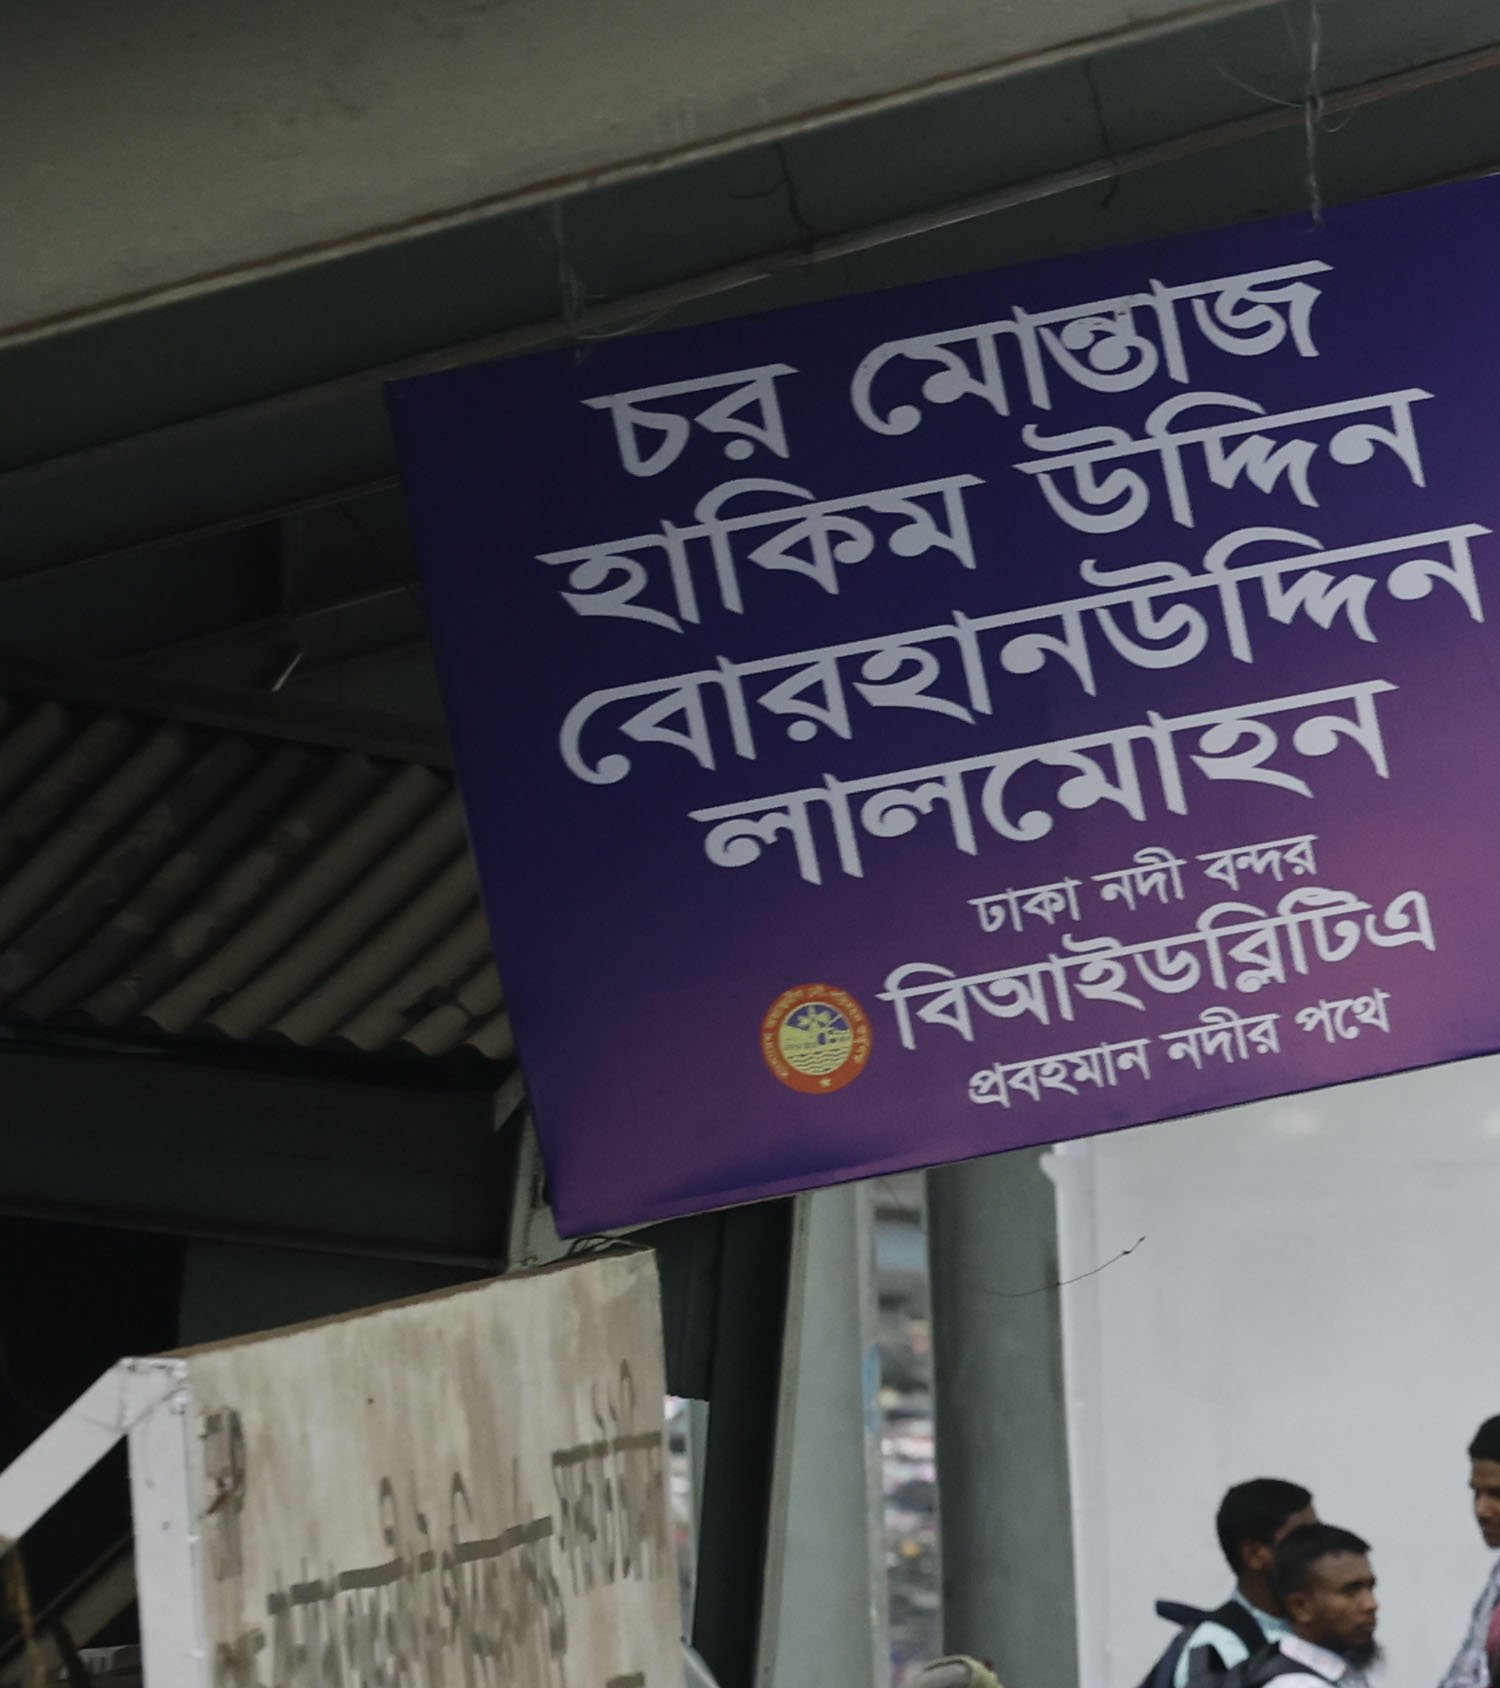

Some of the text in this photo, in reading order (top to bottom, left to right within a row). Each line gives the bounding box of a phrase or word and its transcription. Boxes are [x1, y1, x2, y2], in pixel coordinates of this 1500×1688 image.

[582, 259, 1334, 478] চর মোন্তাজ
[534, 386, 1436, 634] হাকিম উদ্দিন
[560, 522, 1493, 787] বোরহানউদ্দিন
[689, 679, 1400, 885] লালমোহন
[968, 834, 1318, 934] ঢাকা নদী বন্দর
[968, 988, 1392, 1108] প্রবহমান নদীর পথে
